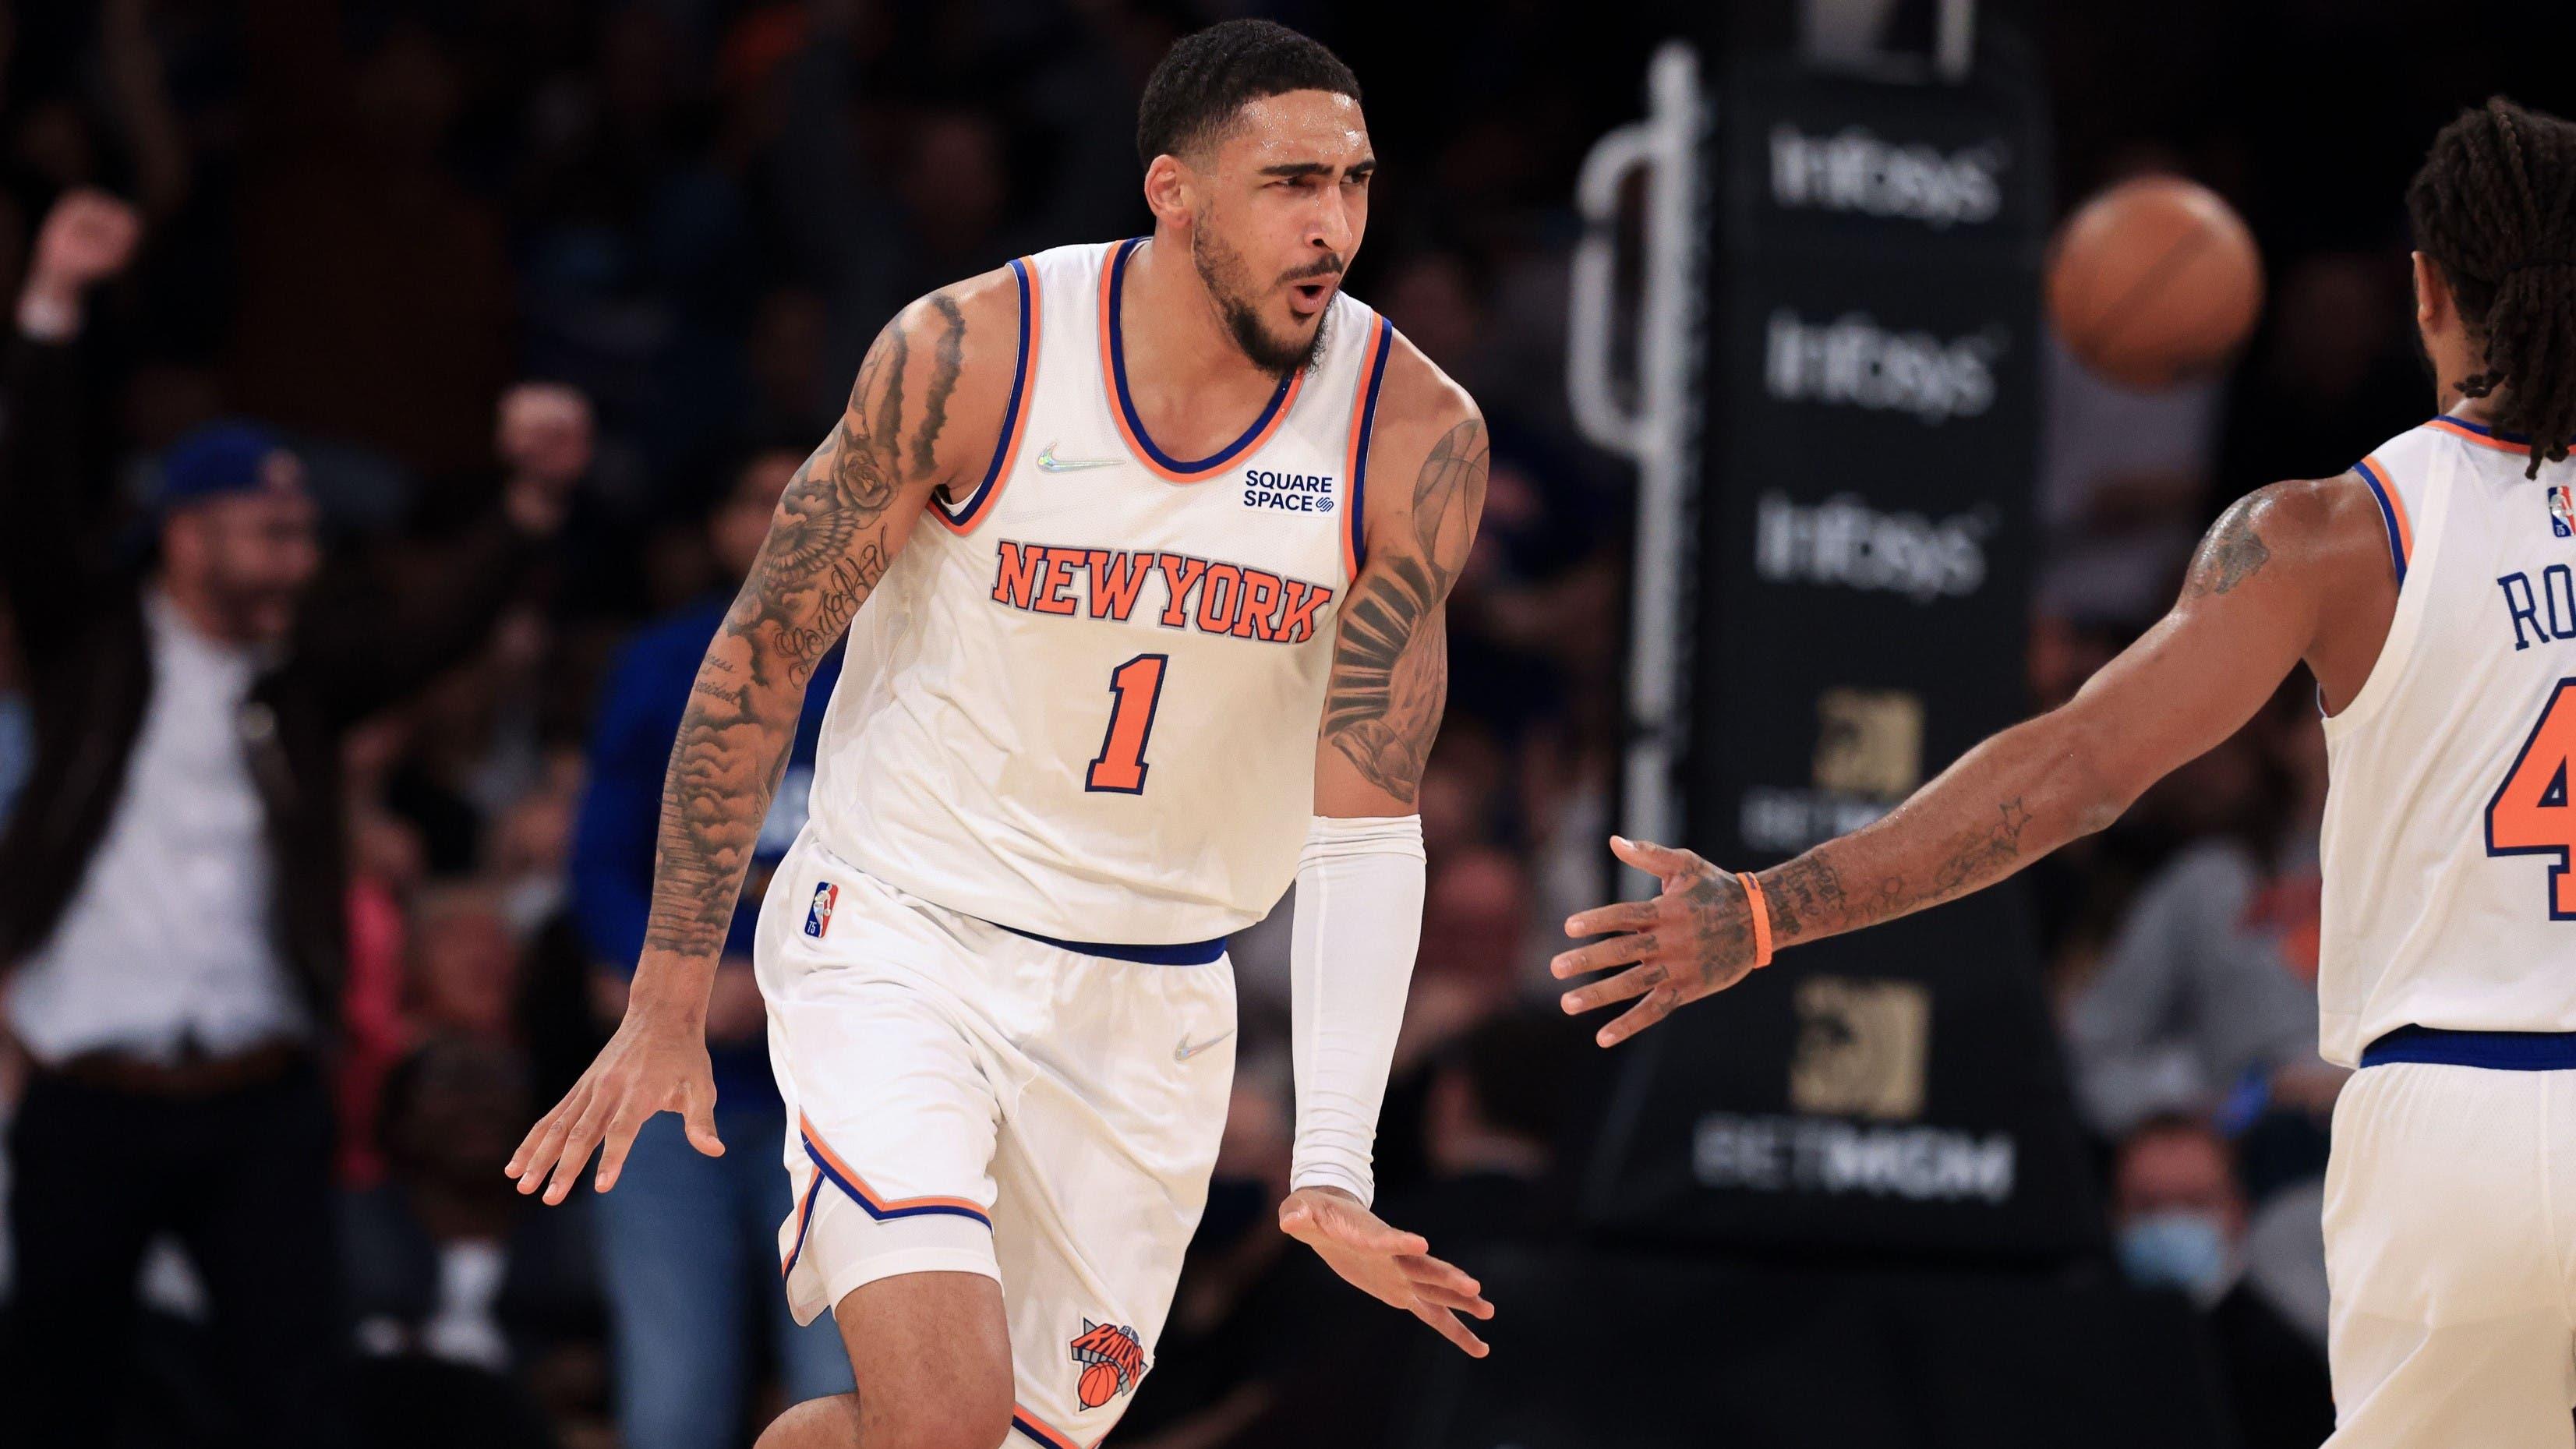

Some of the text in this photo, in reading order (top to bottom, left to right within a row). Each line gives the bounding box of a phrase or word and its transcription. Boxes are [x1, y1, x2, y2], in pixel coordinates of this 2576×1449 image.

[1243, 489, 1313, 511] SPACE
[1246, 470, 1333, 493] SQUARE
[992, 541, 1333, 644] NEW YORK
[1085, 653, 1169, 796] 1
[2485, 677, 2576, 921] 4
[807, 921, 817, 934] 75
[1070, 1323, 1144, 1391] KNICKS
